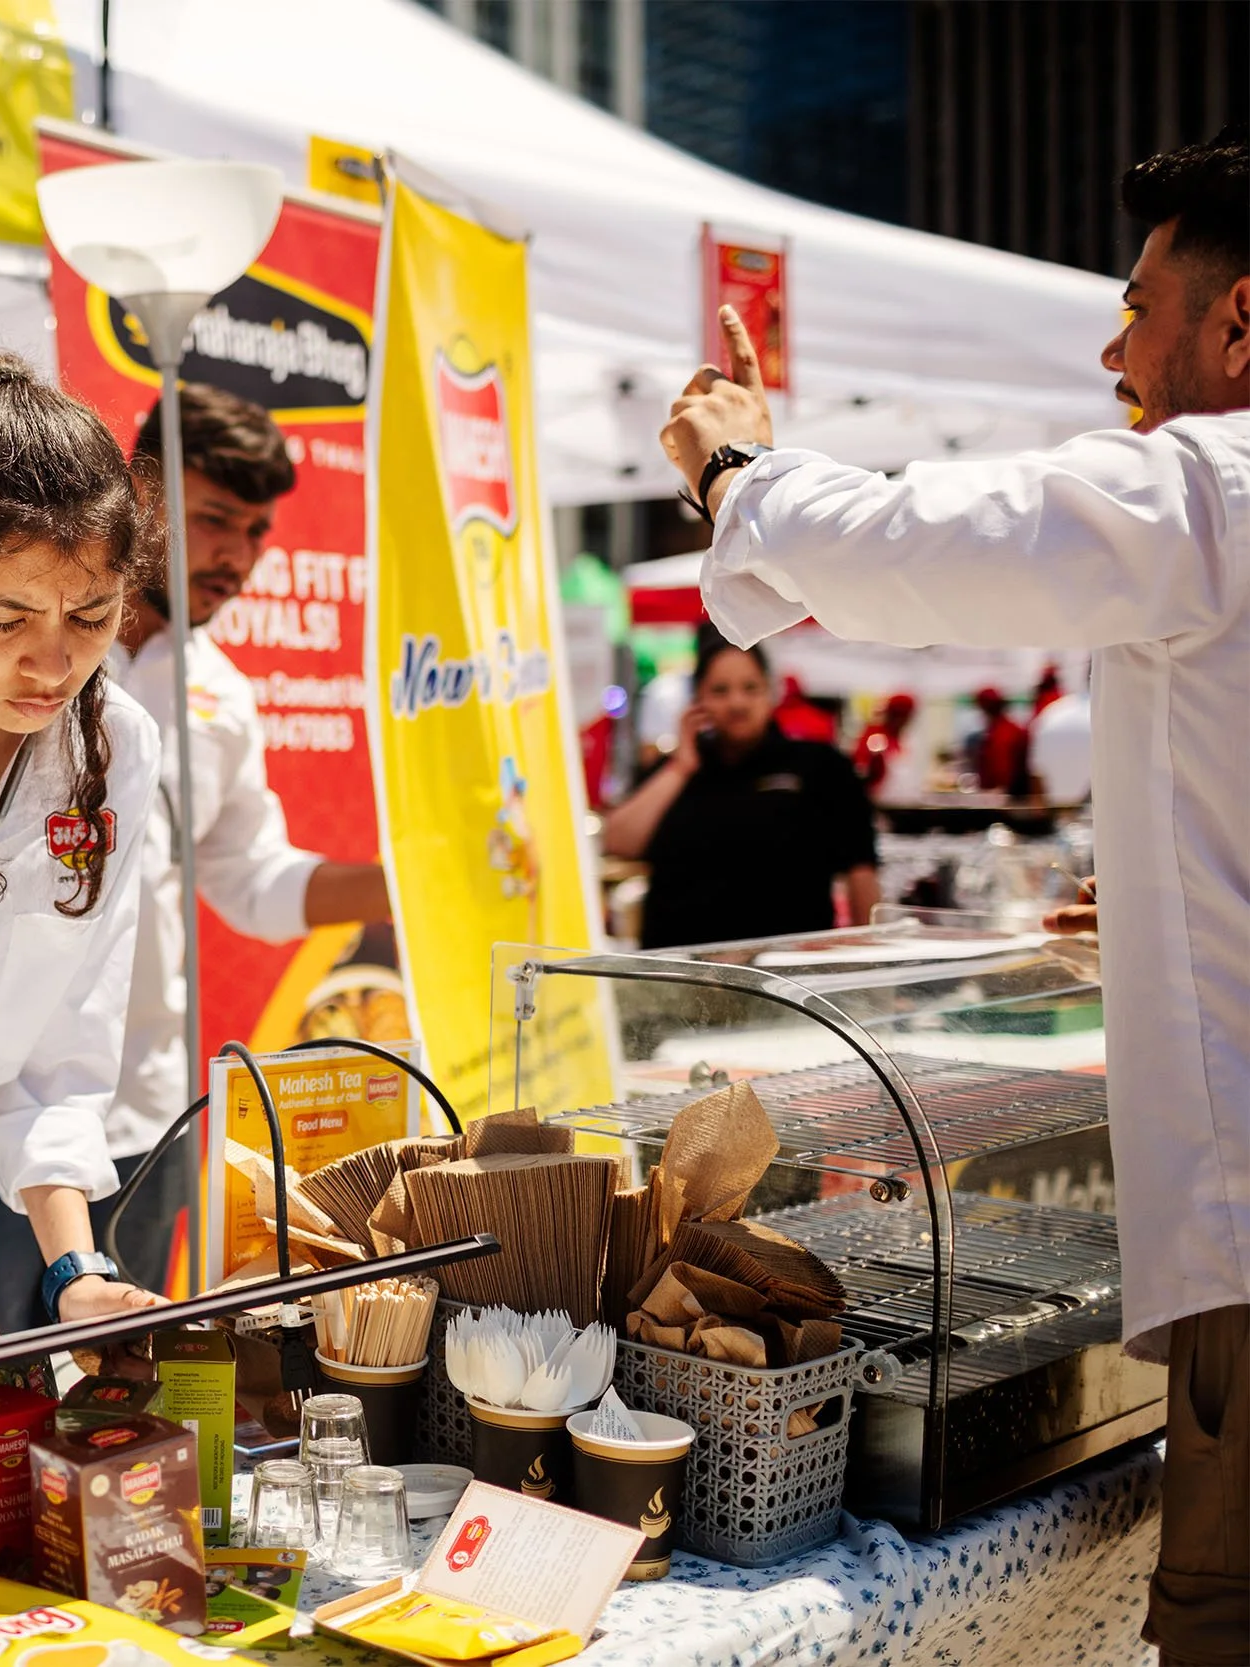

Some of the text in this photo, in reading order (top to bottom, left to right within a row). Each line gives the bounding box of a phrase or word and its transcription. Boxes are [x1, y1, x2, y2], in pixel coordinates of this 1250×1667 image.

[279, 1072, 334, 1095] Mahesh
[339, 1070, 362, 1089] Tea
[297, 1115, 343, 1133] Food Menu
[124, 1525, 166, 1548] KADAK
[107, 1535, 184, 1569] MASALA CHAI
